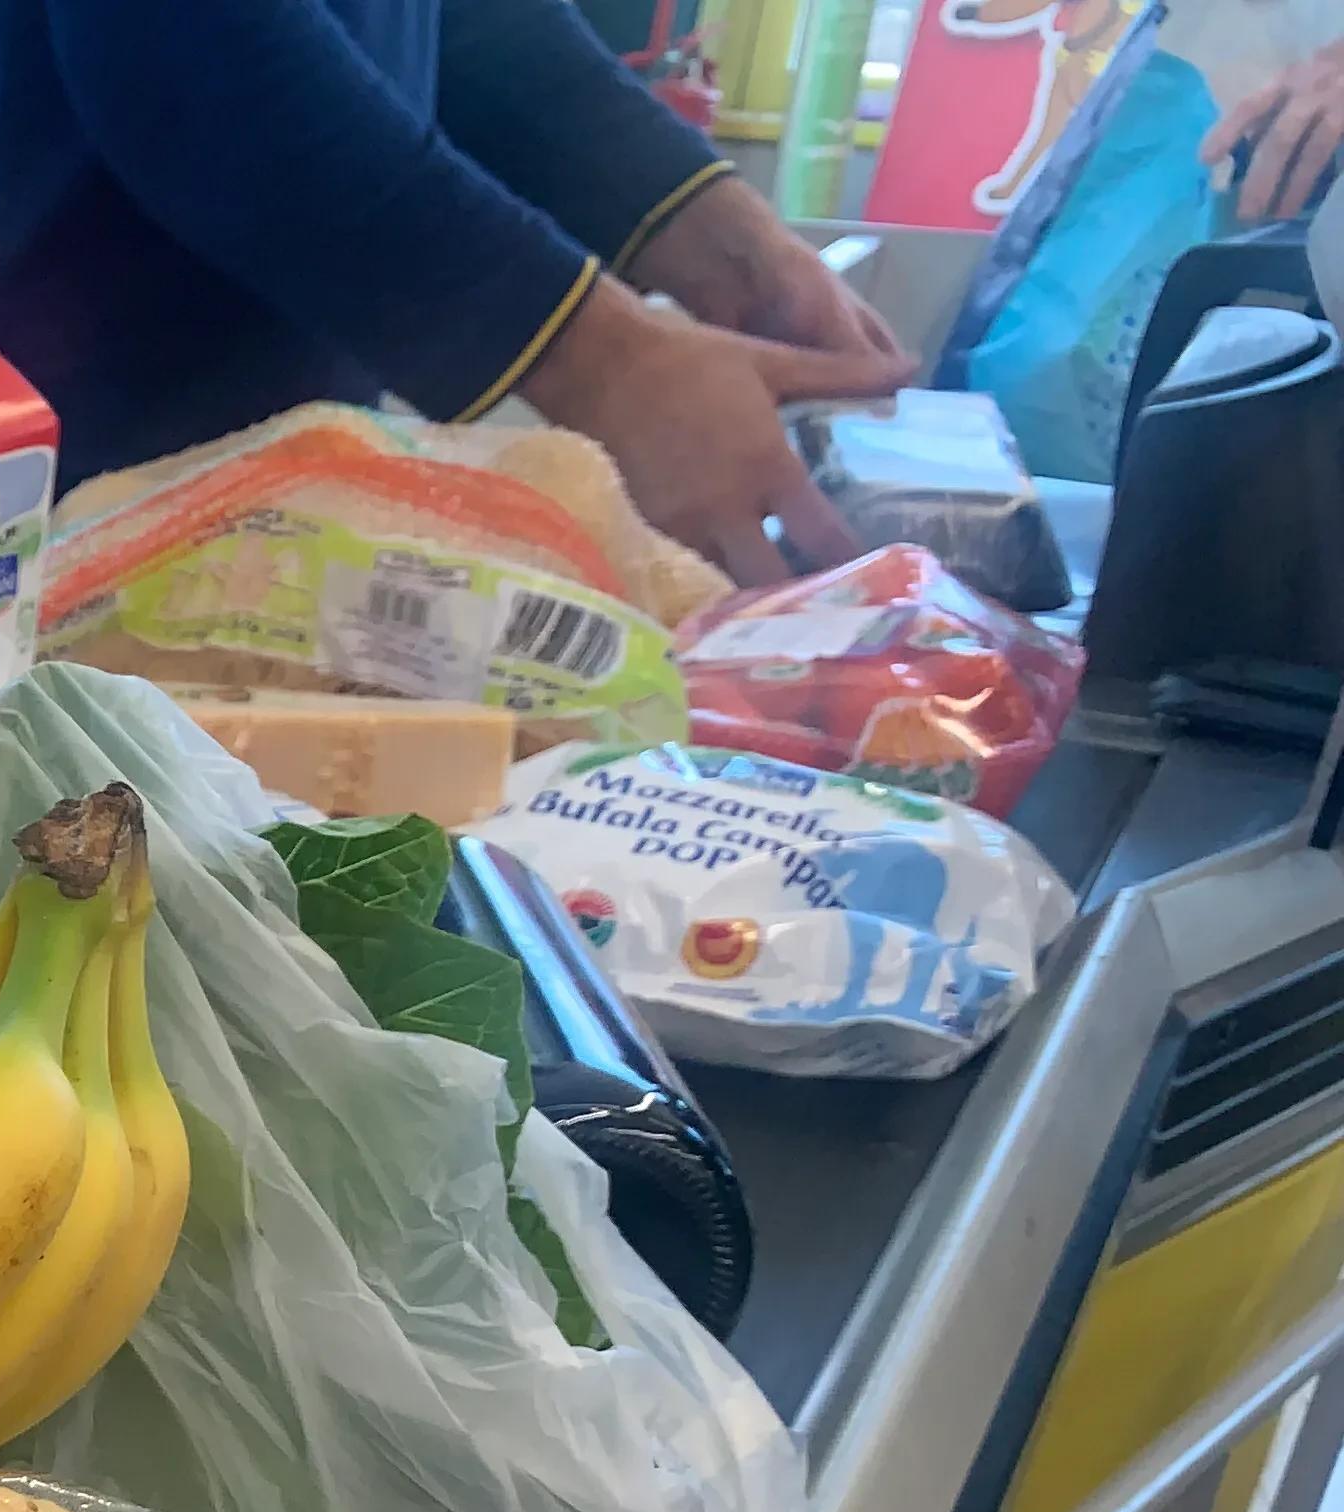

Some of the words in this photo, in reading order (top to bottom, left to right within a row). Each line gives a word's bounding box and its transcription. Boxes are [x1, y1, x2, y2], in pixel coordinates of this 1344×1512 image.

[527, 788, 680, 835] Bufala
[584, 767, 845, 847] Mozzarella
[629, 836, 740, 870] DOP
